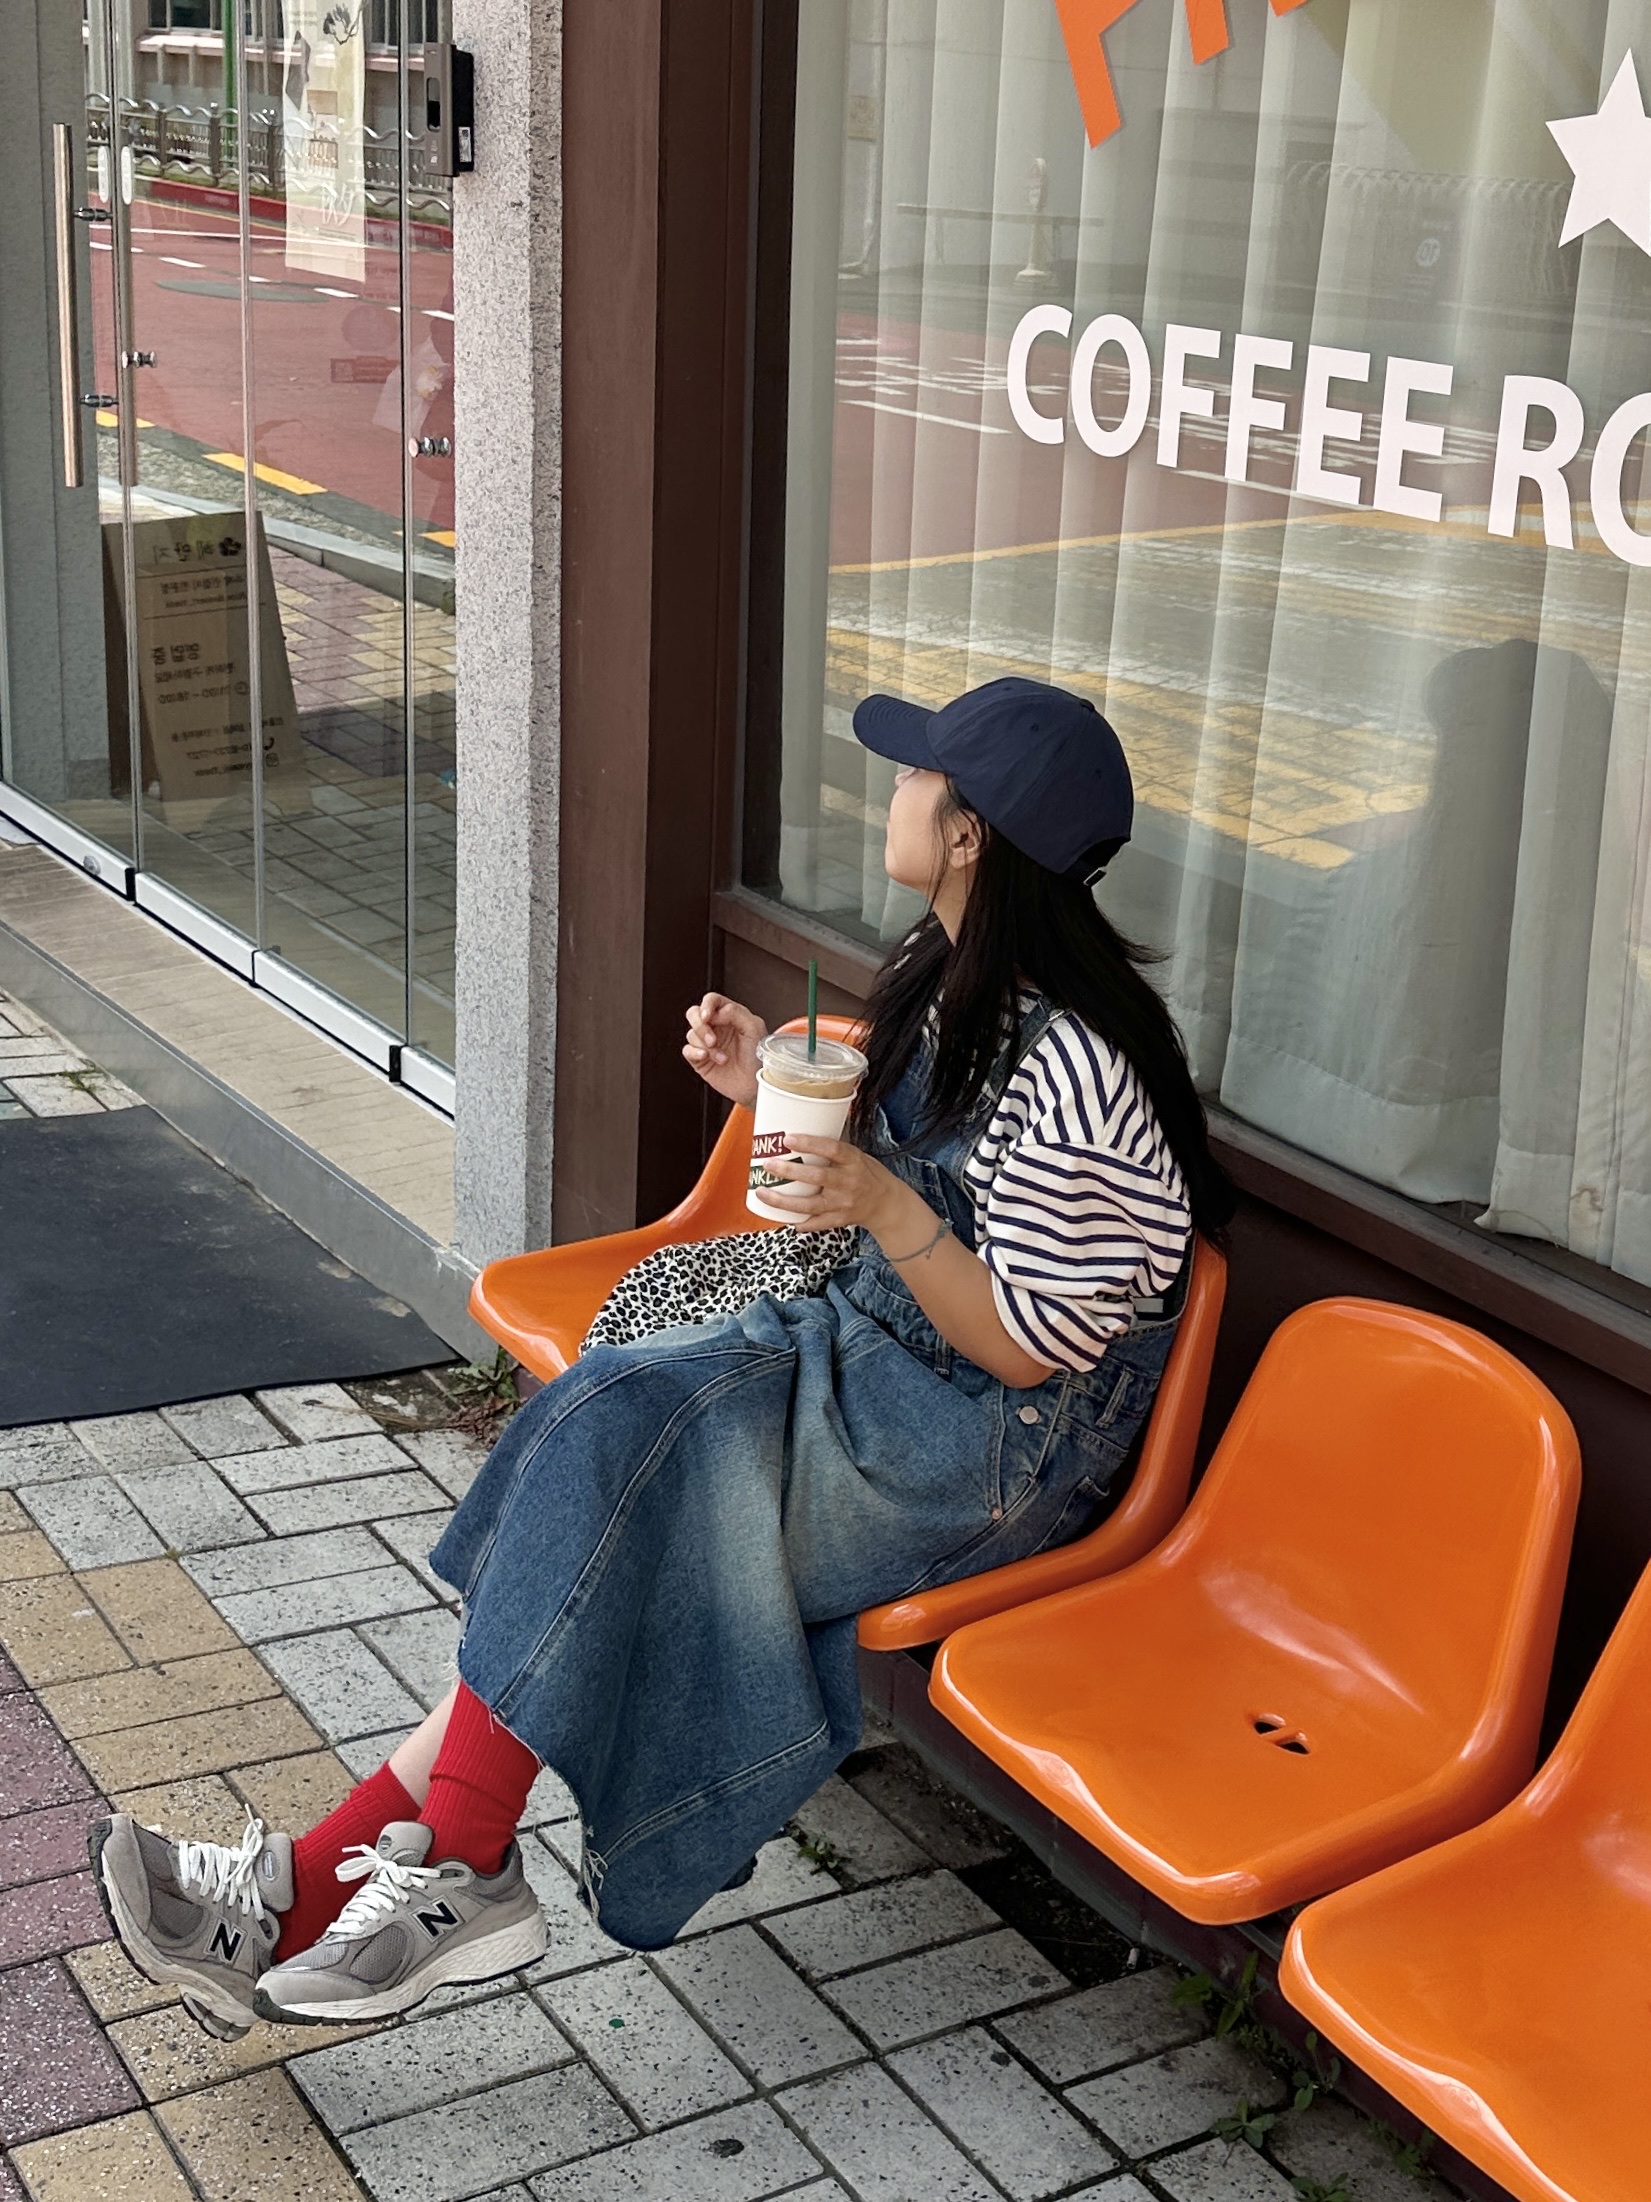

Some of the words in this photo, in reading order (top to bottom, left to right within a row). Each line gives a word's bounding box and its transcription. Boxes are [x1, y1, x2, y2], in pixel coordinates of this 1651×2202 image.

[1007, 304, 1454, 521] COFFEE
[415, 1899, 460, 1939] N
[207, 1920, 244, 1963] N
